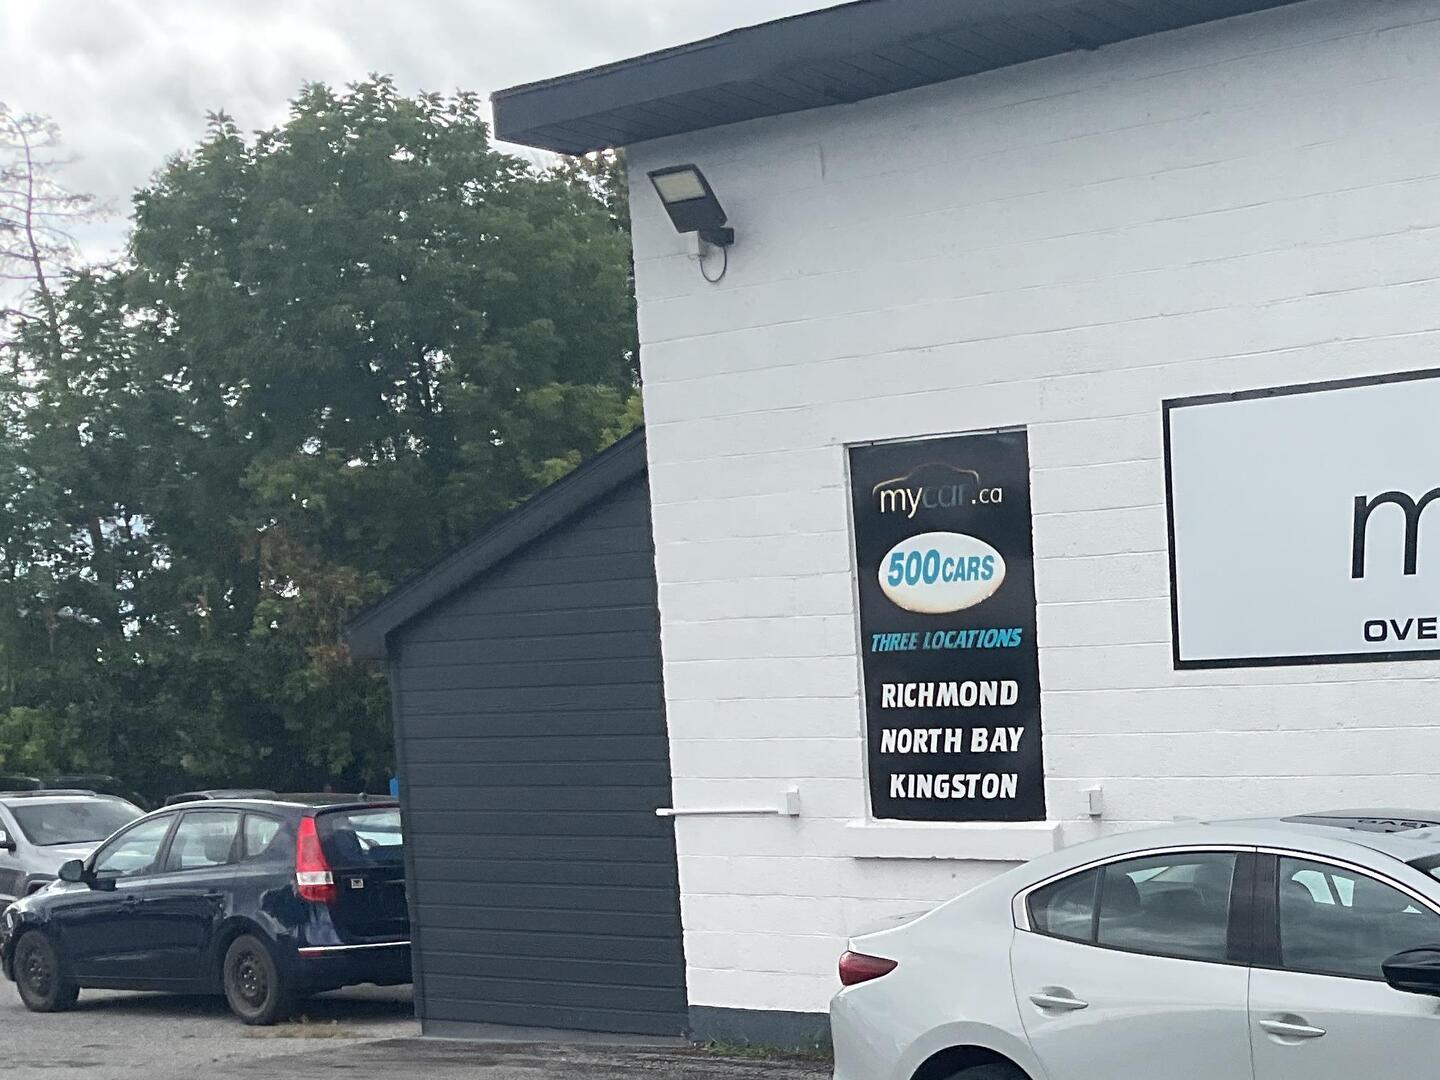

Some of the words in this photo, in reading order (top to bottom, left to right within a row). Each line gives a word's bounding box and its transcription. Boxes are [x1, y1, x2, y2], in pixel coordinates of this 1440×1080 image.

[887, 549, 940, 587] 500
[942, 555, 994, 583] CARS
[871, 632, 918, 652] THREE
[923, 628, 1022, 650] LOCATIONS
[881, 680, 1019, 709] RICHMOND
[880, 728, 962, 753] NORTH
[971, 727, 1025, 752] BAY
[889, 773, 1018, 799] KINGSTON
